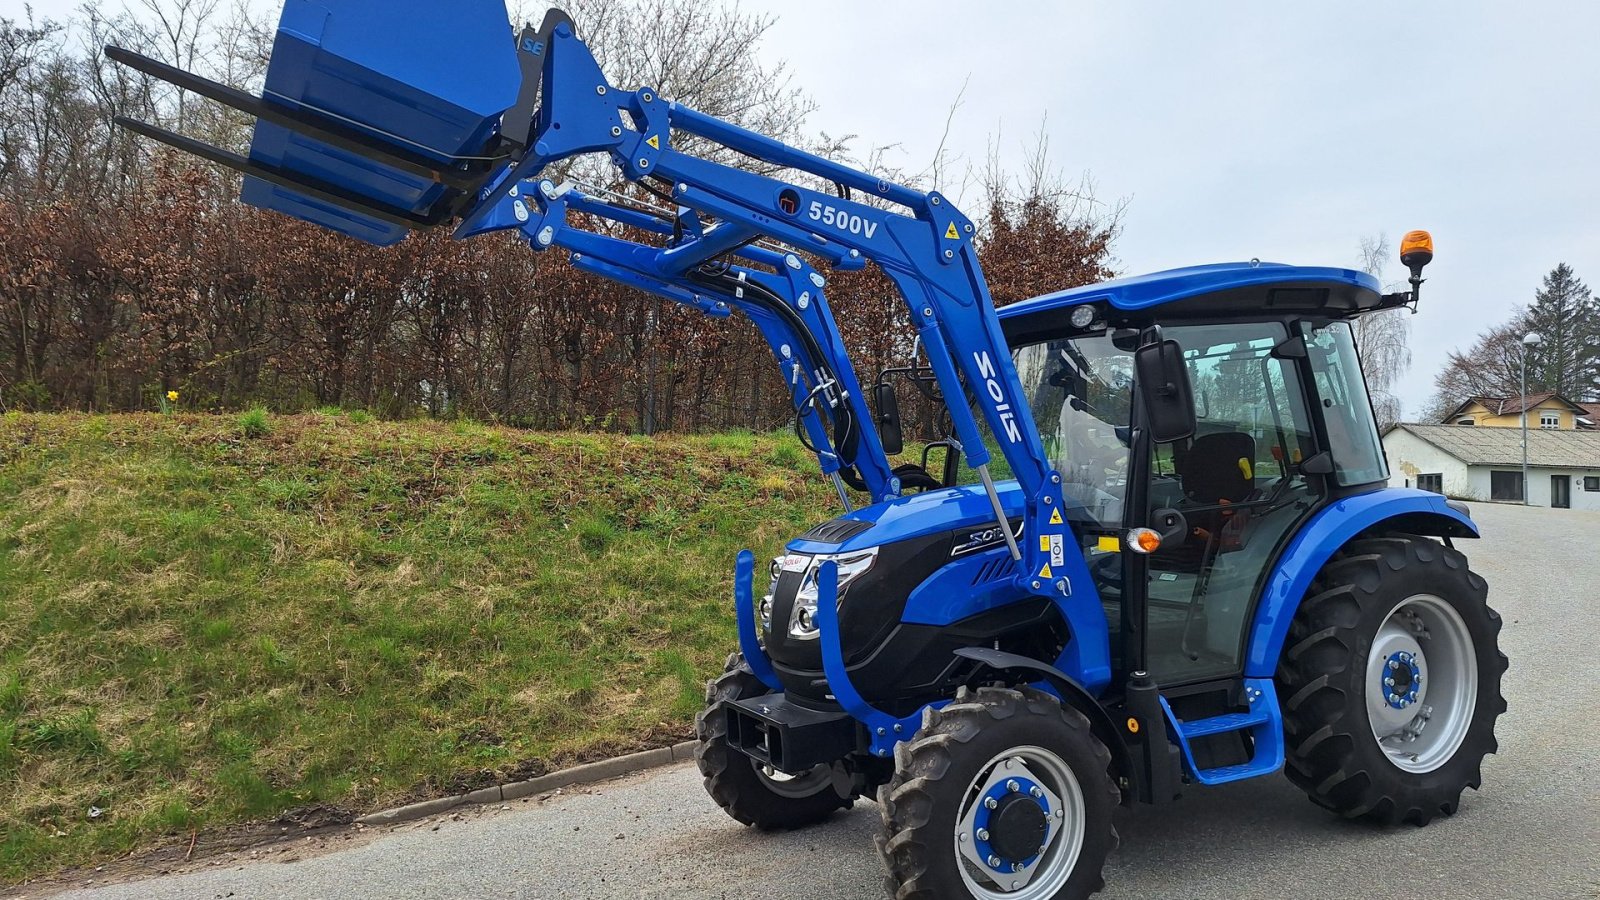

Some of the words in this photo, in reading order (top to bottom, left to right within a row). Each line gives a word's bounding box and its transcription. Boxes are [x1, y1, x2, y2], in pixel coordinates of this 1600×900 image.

[522, 37, 544, 56] SE
[808, 200, 878, 239] 5500V
[973, 351, 1022, 443] SOLIS
